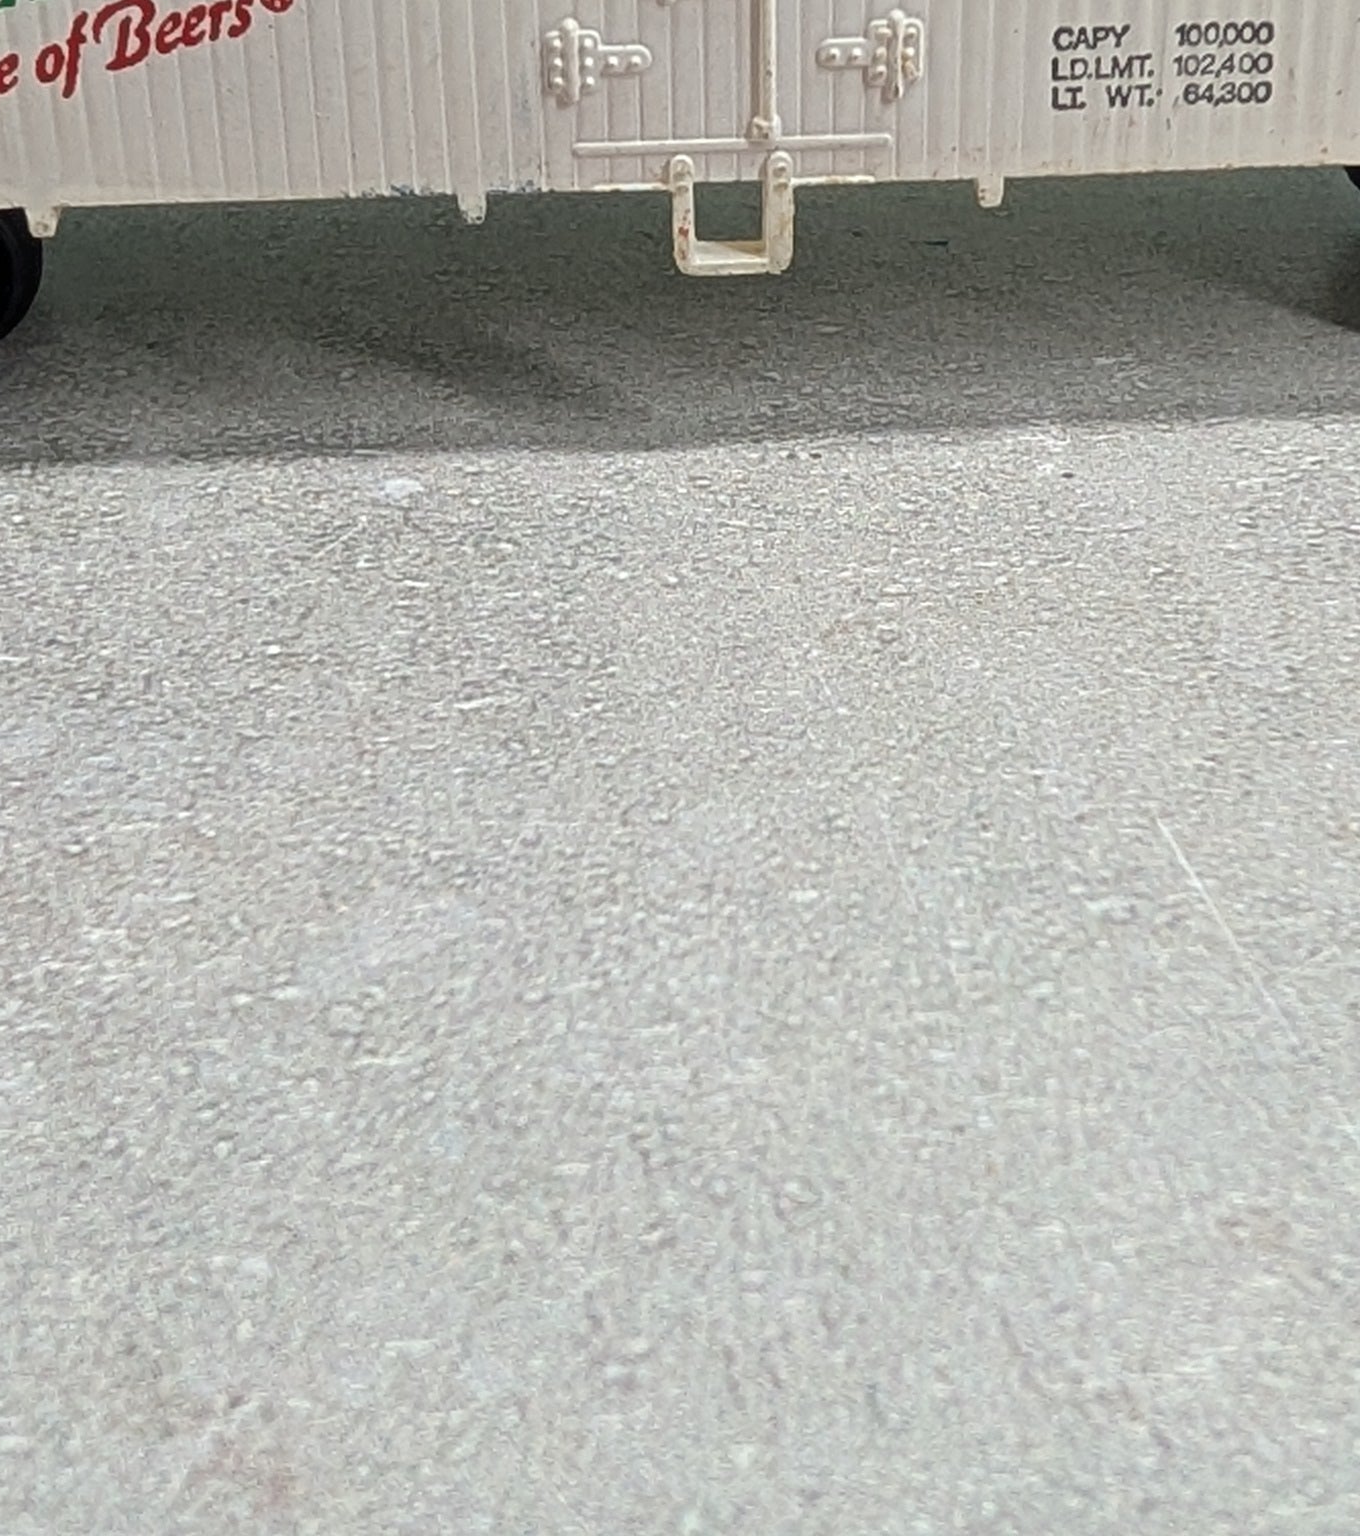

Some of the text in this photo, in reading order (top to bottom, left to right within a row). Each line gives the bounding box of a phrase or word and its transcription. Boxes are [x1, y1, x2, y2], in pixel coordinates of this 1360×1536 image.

[1051, 20, 1275, 52] CAPY 100,000
[34, 11, 89, 99] of
[1172, 50, 1274, 80] 102,400
[1181, 80, 1274, 108] 64,300
